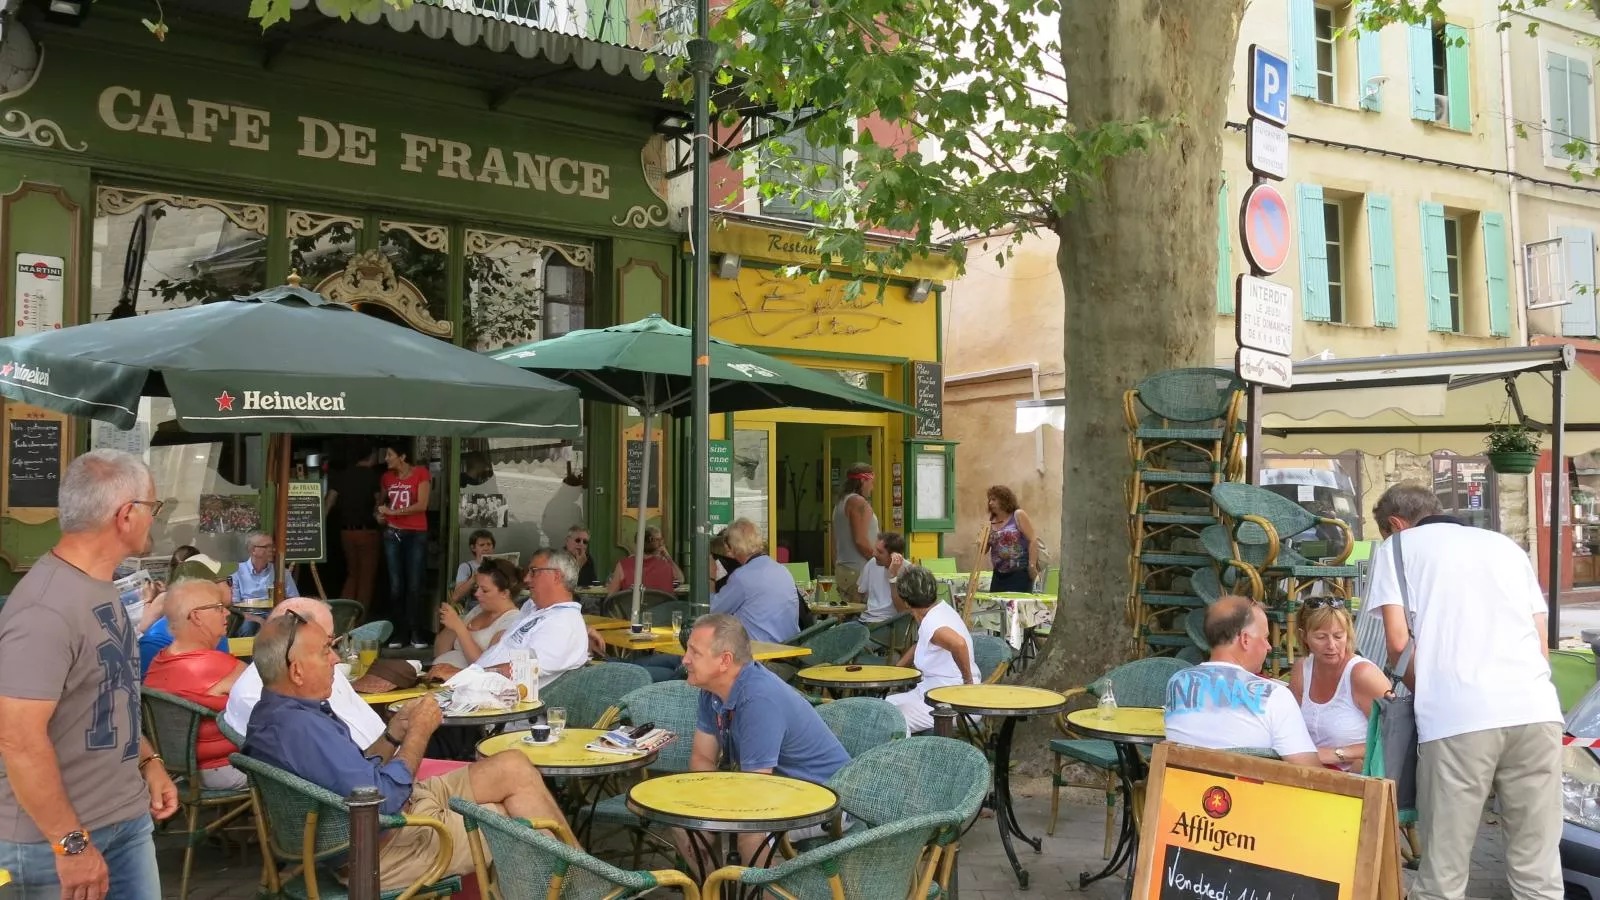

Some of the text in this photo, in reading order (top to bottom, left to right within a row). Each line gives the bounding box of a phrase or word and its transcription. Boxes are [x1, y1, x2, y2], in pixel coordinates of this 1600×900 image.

[1263, 63, 1280, 104] P
[98, 86, 610, 200] CAFE DE FRANCE
[20, 266, 61, 275] MARTINI
[1249, 283, 1288, 306] INTERDIT
[1256, 303, 1263, 313] LE
[1244, 313, 1291, 335] ET LE DIMANCHE
[243, 391, 346, 411] Heineken
[388, 490, 410, 510] 79
[1171, 811, 1257, 851] Affligem
[1168, 846, 1231, 900] Vendredi
